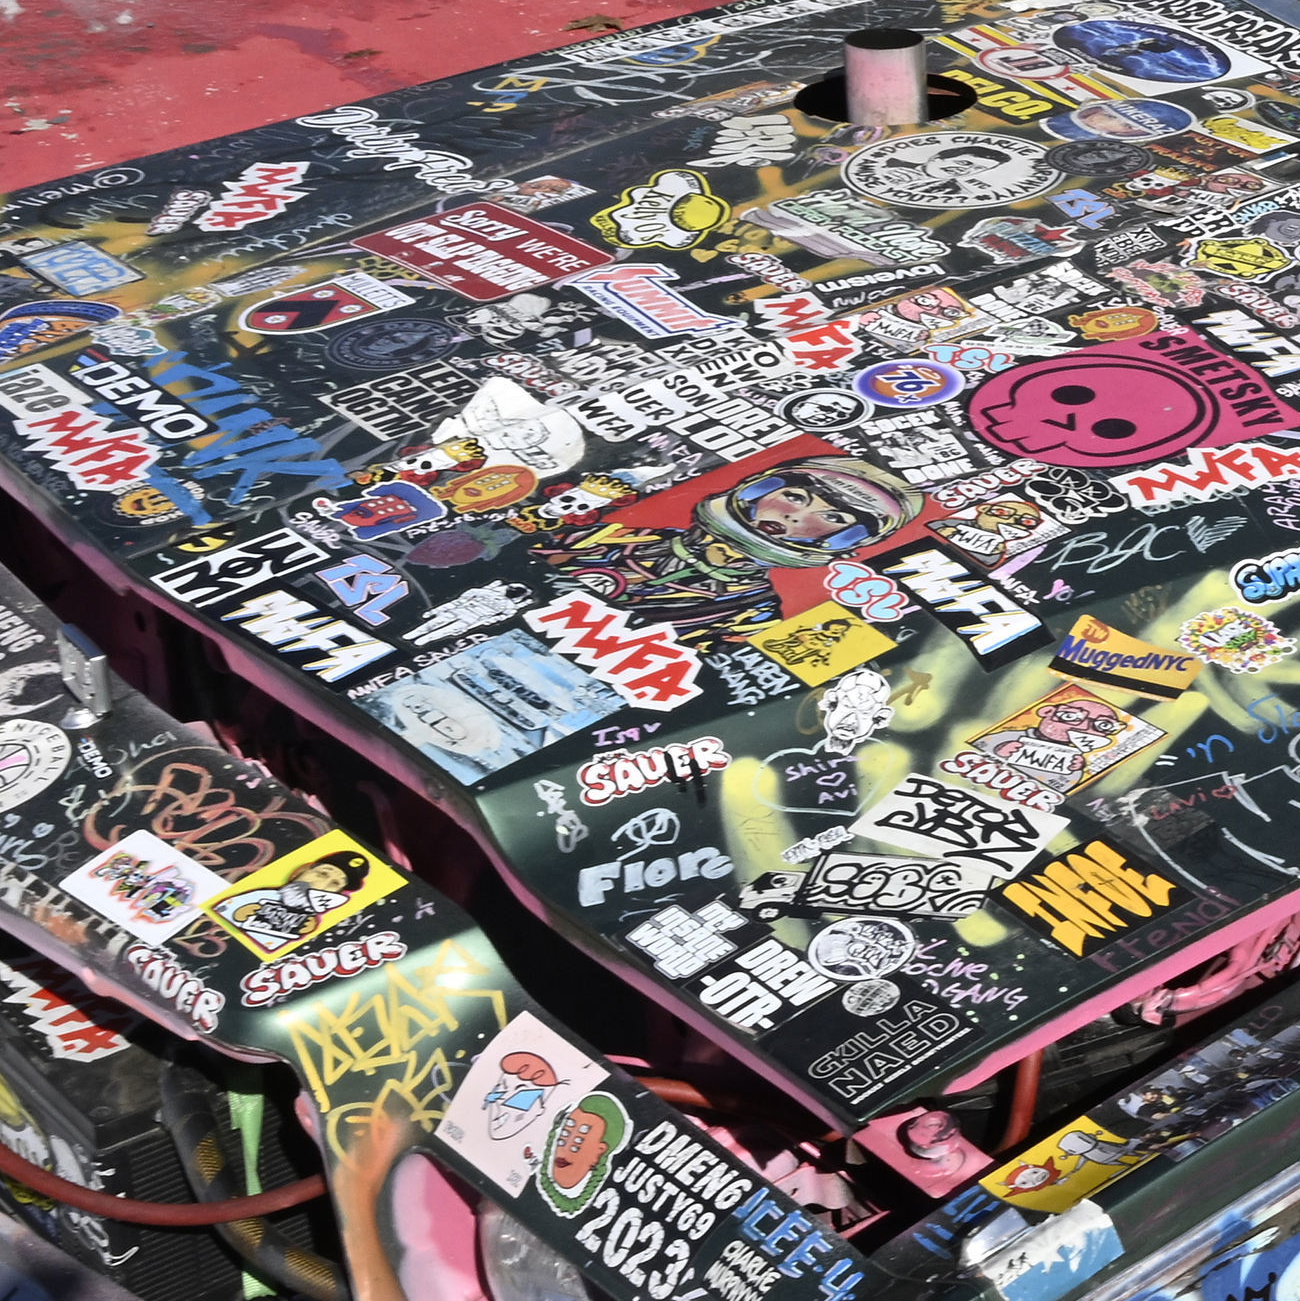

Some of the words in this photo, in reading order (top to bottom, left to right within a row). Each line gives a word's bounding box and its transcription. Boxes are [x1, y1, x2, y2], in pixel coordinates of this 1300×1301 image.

[852, 157, 884, 190] AMUSE
[879, 136, 941, 158] DOES
[950, 135, 1031, 161] CHARLIE
[200, 164, 309, 230] MWFA
[622, 189, 673, 224] Kelly
[440, 209, 529, 241] Sorry
[516, 238, 590, 273] WE'RE
[779, 199, 837, 228] DERBY
[836, 223, 920, 262] PODCAST
[728, 251, 812, 293] SAUER
[608, 302, 662, 337] EQUIPMENT
[485, 351, 581, 397] SAUER
[923, 344, 1019, 374] TSL
[1138, 334, 1285, 429] SMETSKY
[73, 360, 211, 441] DEMO
[859, 408, 942, 437] SOCEK
[27, 409, 152, 486] MWFA
[900, 457, 978, 485] DONE
[933, 460, 1048, 510] SAUER
[823, 561, 909, 622] TSL
[538, 599, 693, 703] MWFA
[1058, 633, 1196, 674] MuggedNYC
[77, 735, 114, 780] DEMO
[576, 736, 732, 806] SAUER
[940, 751, 1066, 812] SAUER
[1019, 746, 1067, 774] MWFA
[626, 921, 707, 979] WORLD
[654, 905, 738, 963] INSANE
[128, 943, 226, 1034] SAUER
[242, 931, 408, 1006] SAUER
[735, 939, 838, 1006] DREW
[830, 1008, 960, 1098] NAED
[612, 1158, 717, 1241] JUSTY69
[574, 1188, 696, 1298] 2023
[719, 1239, 782, 1292] CHARLIE
